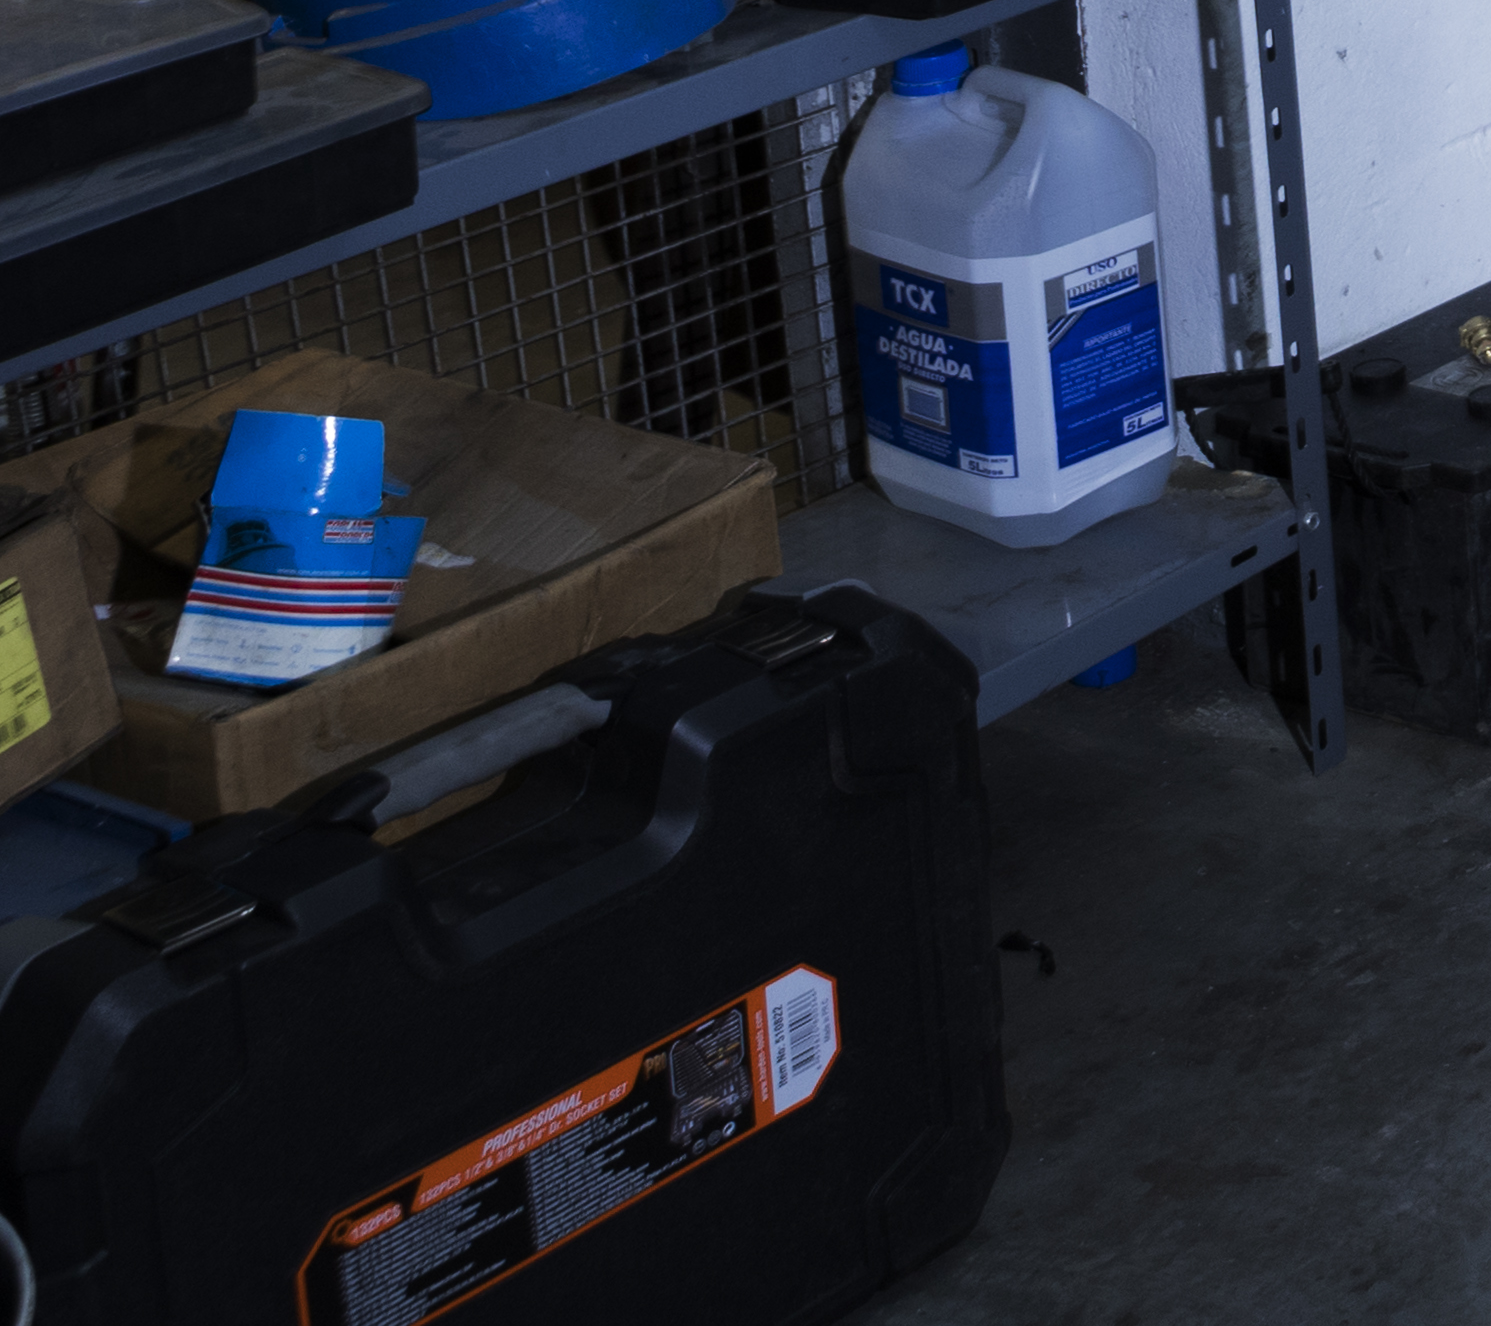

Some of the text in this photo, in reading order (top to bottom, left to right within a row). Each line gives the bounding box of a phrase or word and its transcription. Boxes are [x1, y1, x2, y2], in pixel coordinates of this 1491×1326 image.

[1067, 265, 1138, 299] DIRECTO
[1086, 256, 1118, 275] USO
[889, 277, 937, 315] TCX
[893, 324, 948, 355] AGUA
[878, 335, 974, 382] DESTILADA
[913, 366, 946, 383] DIRECTO
[777, 1065, 789, 1088] Item
[481, 1090, 583, 1157] PROFESSIONAL
[350, 1203, 402, 1242] 132PCS
